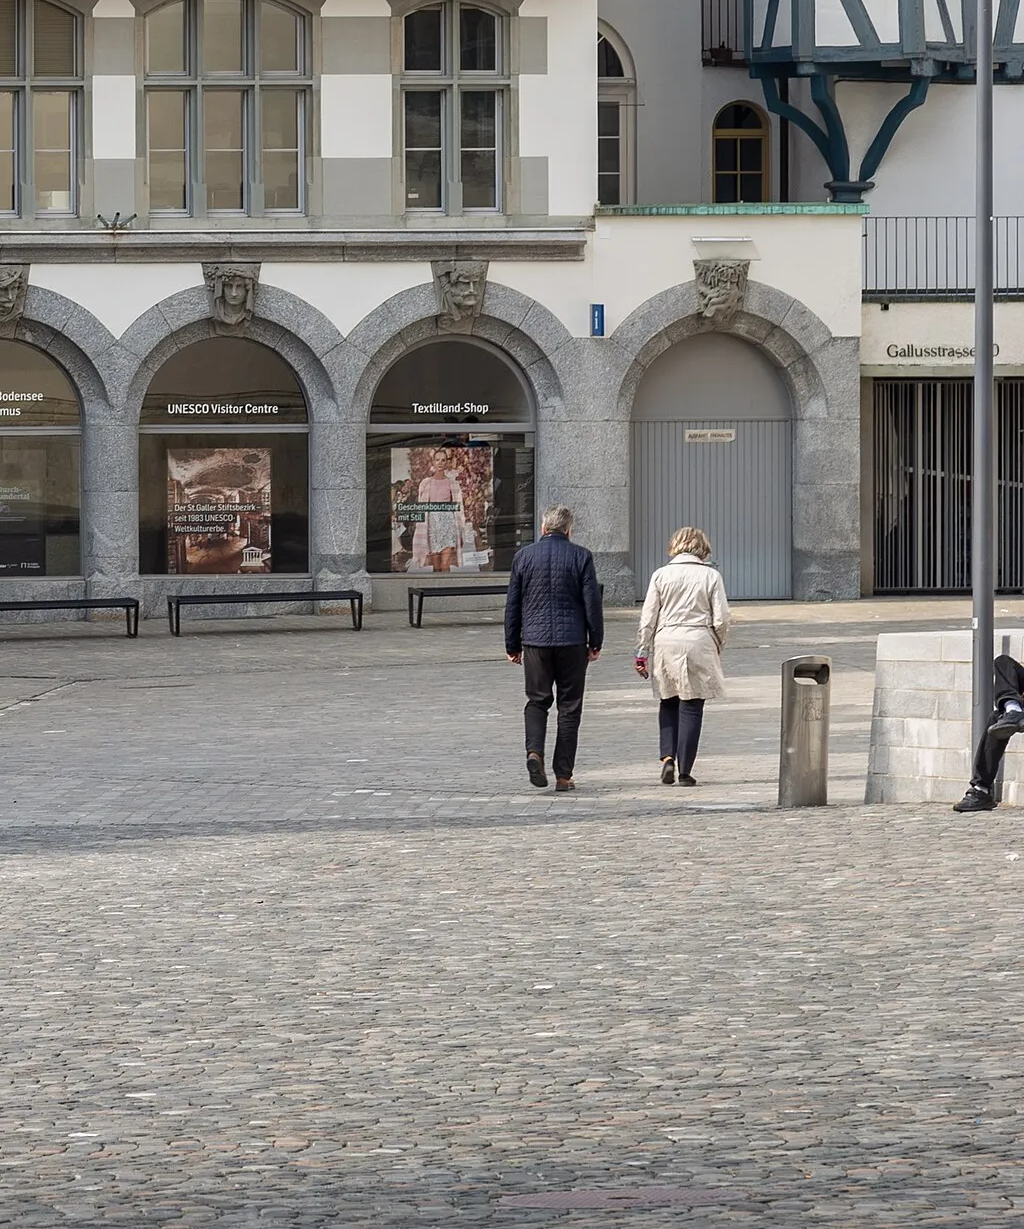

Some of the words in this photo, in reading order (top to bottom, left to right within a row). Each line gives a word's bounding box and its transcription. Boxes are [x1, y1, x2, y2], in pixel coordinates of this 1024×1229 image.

[886, 343, 976, 359] Gallusstrasse
[167, 403, 210, 414] UNESCO
[211, 403, 244, 414] Visitor
[245, 403, 279, 414] Centre
[412, 402, 489, 415] Textilland-Shop
[174, 504, 186, 512] Der
[187, 503, 216, 512] St.Galler
[217, 503, 256, 512] Stiftsbezirk
[397, 503, 459, 512] Geschenkboutique
[174, 514, 187, 522] seit
[187, 514, 203, 522] 1983
[204, 514, 236, 522] UNESCO-
[397, 513, 409, 521] mit
[174, 525, 227, 533] Weltkulturerbe.
